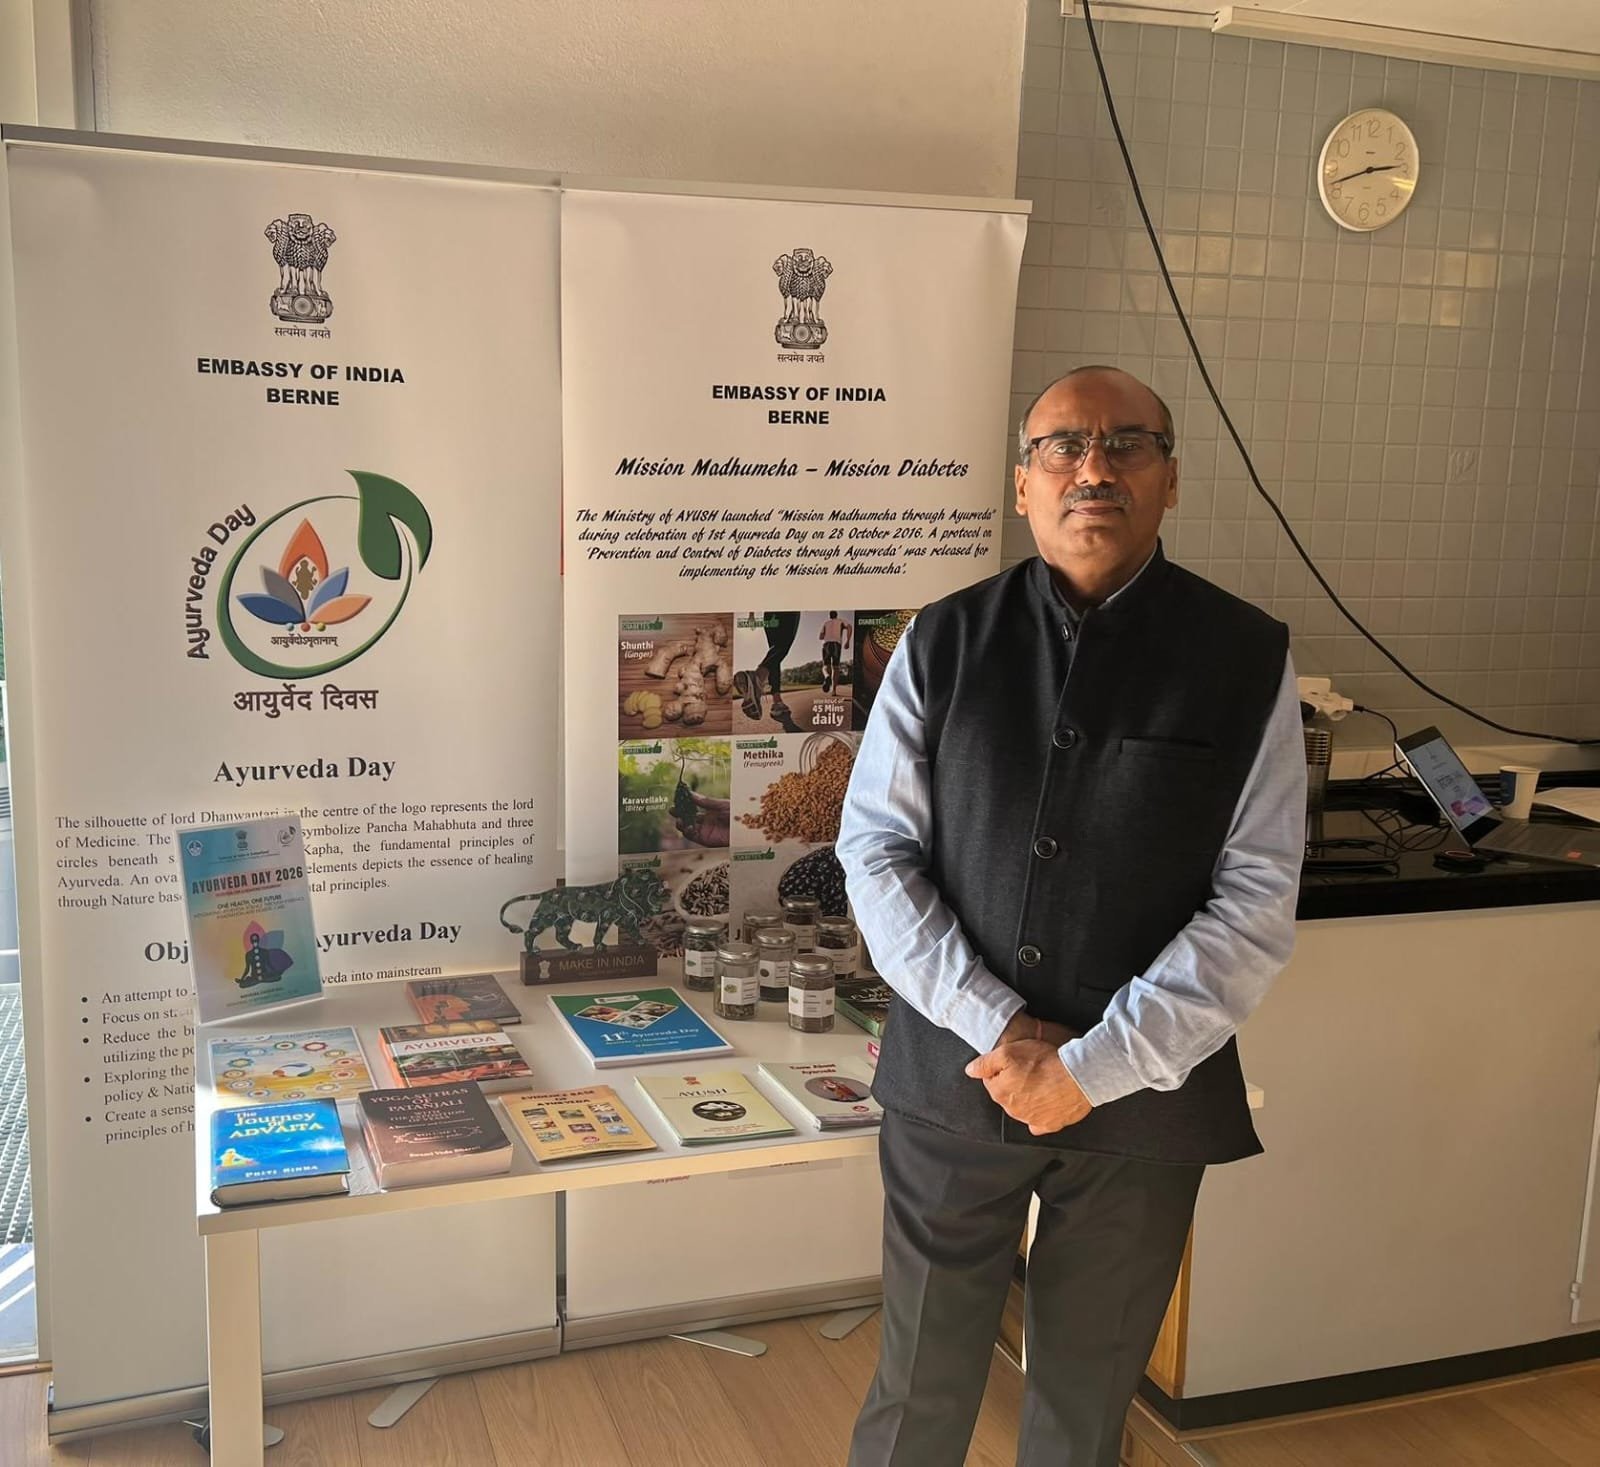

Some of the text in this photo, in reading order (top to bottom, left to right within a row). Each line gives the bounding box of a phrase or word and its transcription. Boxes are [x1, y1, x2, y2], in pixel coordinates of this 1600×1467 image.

[1351, 125, 1361, 141] 11
[1368, 119, 1380, 138] 12
[1386, 126, 1392, 144] 1
[1395, 142, 1406, 160] 2
[1390, 189, 1400, 200] 4
[1345, 197, 1354, 217] 7
[1359, 202, 1369, 222] 6
[1376, 198, 1386, 216] 5
[198, 358, 404, 383] EMBASSY OF INDIA
[267, 388, 339, 405] BERNE
[713, 385, 886, 401] EMBASSY OF INDIA
[769, 411, 829, 424] BERNE
[615, 457, 968, 477] Mission Madhumeha Mission Diabetes
[576, 509, 598, 521] The
[602, 510, 655, 525] Ministry
[659, 509, 672, 524] of
[675, 510, 719, 521] AYUSH
[721, 509, 774, 521] launched
[828, 509, 896, 520] Madhumeha
[902, 508, 945, 523] through
[579, 528, 619, 544] during
[625, 528, 686, 541] celebration
[692, 527, 705, 543] of
[708, 529, 725, 540] 1st
[728, 528, 780, 544] Ayurveda
[786, 528, 808, 543] Day
[812, 531, 824, 539] on
[829, 528, 844, 539] 28
[849, 527, 890, 539] October
[893, 528, 923, 538] 2016.
[928, 527, 937, 538] A
[940, 527, 981, 542] protocol
[656, 546, 680, 559] and
[683, 547, 724, 558] Control
[728, 545, 740, 560] of
[744, 546, 792, 558] Diabetes
[797, 545, 840, 560] through
[904, 548, 927, 556] was
[930, 544, 973, 556] released
[974, 543, 988, 558] for
[679, 565, 756, 580] implementing
[761, 564, 779, 576] the
[187, 504, 256, 660] Ayurveda Day
[621, 642, 654, 650] Shunthi
[233, 683, 378, 718] आयुर्वेद दिवस
[812, 713, 844, 726] daily
[744, 750, 783, 759] Methika
[214, 756, 395, 787] Ayurveda Day
[744, 760, 783, 768] (Fenugreek)
[58, 798, 533, 828] The silhouette of lord the centre of the logo represents the lord
[302, 817, 533, 839] symbolize Pancha Mahabhuta and three
[56, 833, 170, 848] of Medicine. The
[353, 834, 535, 852] the fundamental principles of
[57, 853, 158, 867] circles beneath
[363, 859, 403, 872] depicts
[408, 857, 424, 868] the
[430, 858, 472, 866] essence
[478, 854, 491, 865] of
[495, 853, 533, 865] healing
[58, 874, 148, 890] Ayurveda. An
[192, 875, 248, 894] AYURVEDA
[252, 872, 271, 885] DAY
[276, 866, 302, 881] 2026
[330, 878, 390, 894] principles.
[58, 895, 106, 909] through
[112, 895, 154, 905] Nature
[421, 922, 461, 943] Day
[560, 955, 644, 970] MAKE IN INDIA
[352, 972, 373, 981] into
[377, 967, 441, 979] mainstream
[102, 988, 187, 1003] An attempt to
[103, 1012, 159, 1024] Focus on
[104, 1028, 176, 1044] Reduce the
[404, 1036, 496, 1050] AYURVEDA
[104, 1046, 178, 1063] utilizing the
[105, 1065, 189, 1084] Exploring the
[105, 1087, 158, 1105] policy &
[680, 1088, 727, 1096] AYUSH
[105, 1111, 146, 1122] Create
[161, 1105, 194, 1116] sense
[234, 1113, 316, 1126] Journey
[106, 1121, 185, 1144] principles of
[229, 1123, 324, 1138] ADVAITA
